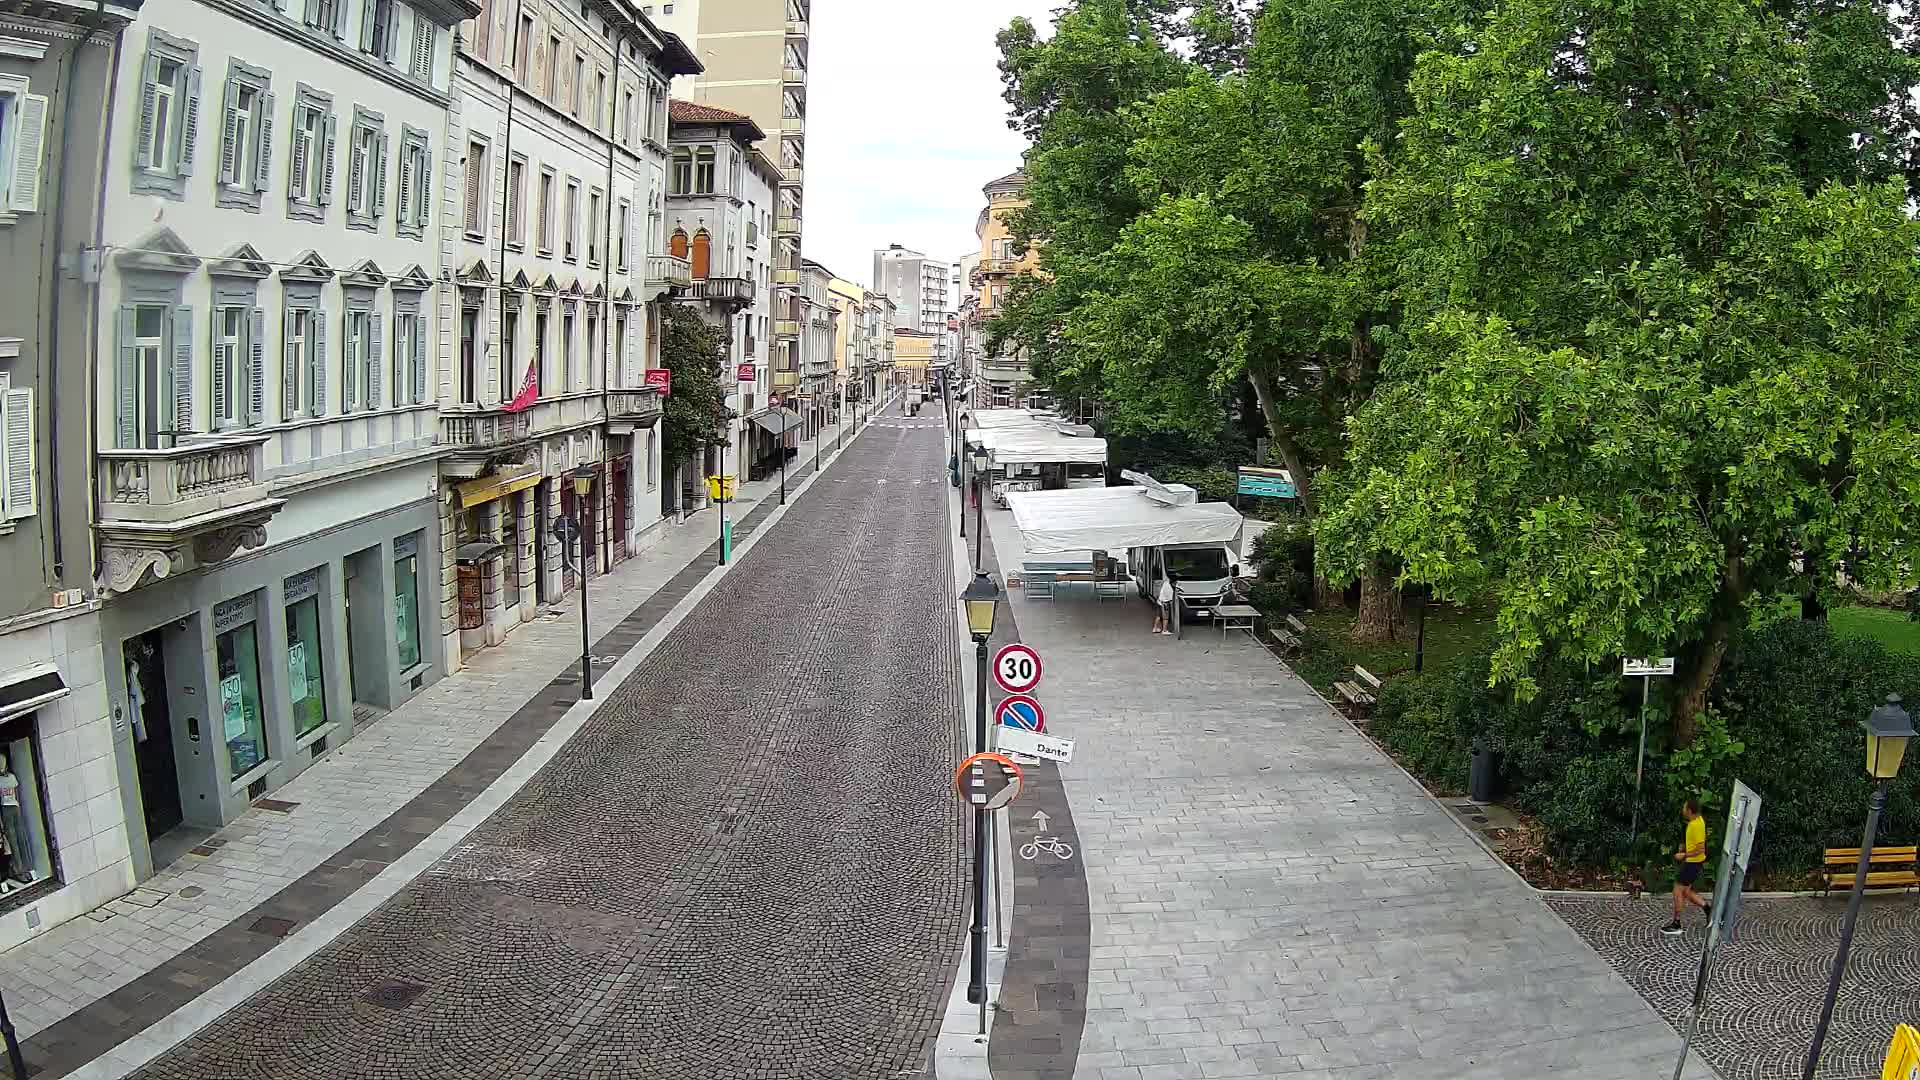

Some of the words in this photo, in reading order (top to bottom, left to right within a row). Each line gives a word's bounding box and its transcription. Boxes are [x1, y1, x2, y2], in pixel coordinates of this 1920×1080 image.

[1005, 658, 1032, 679] 30
[222, 677, 240, 700] 130
[1037, 743, 1068, 758] Dante
